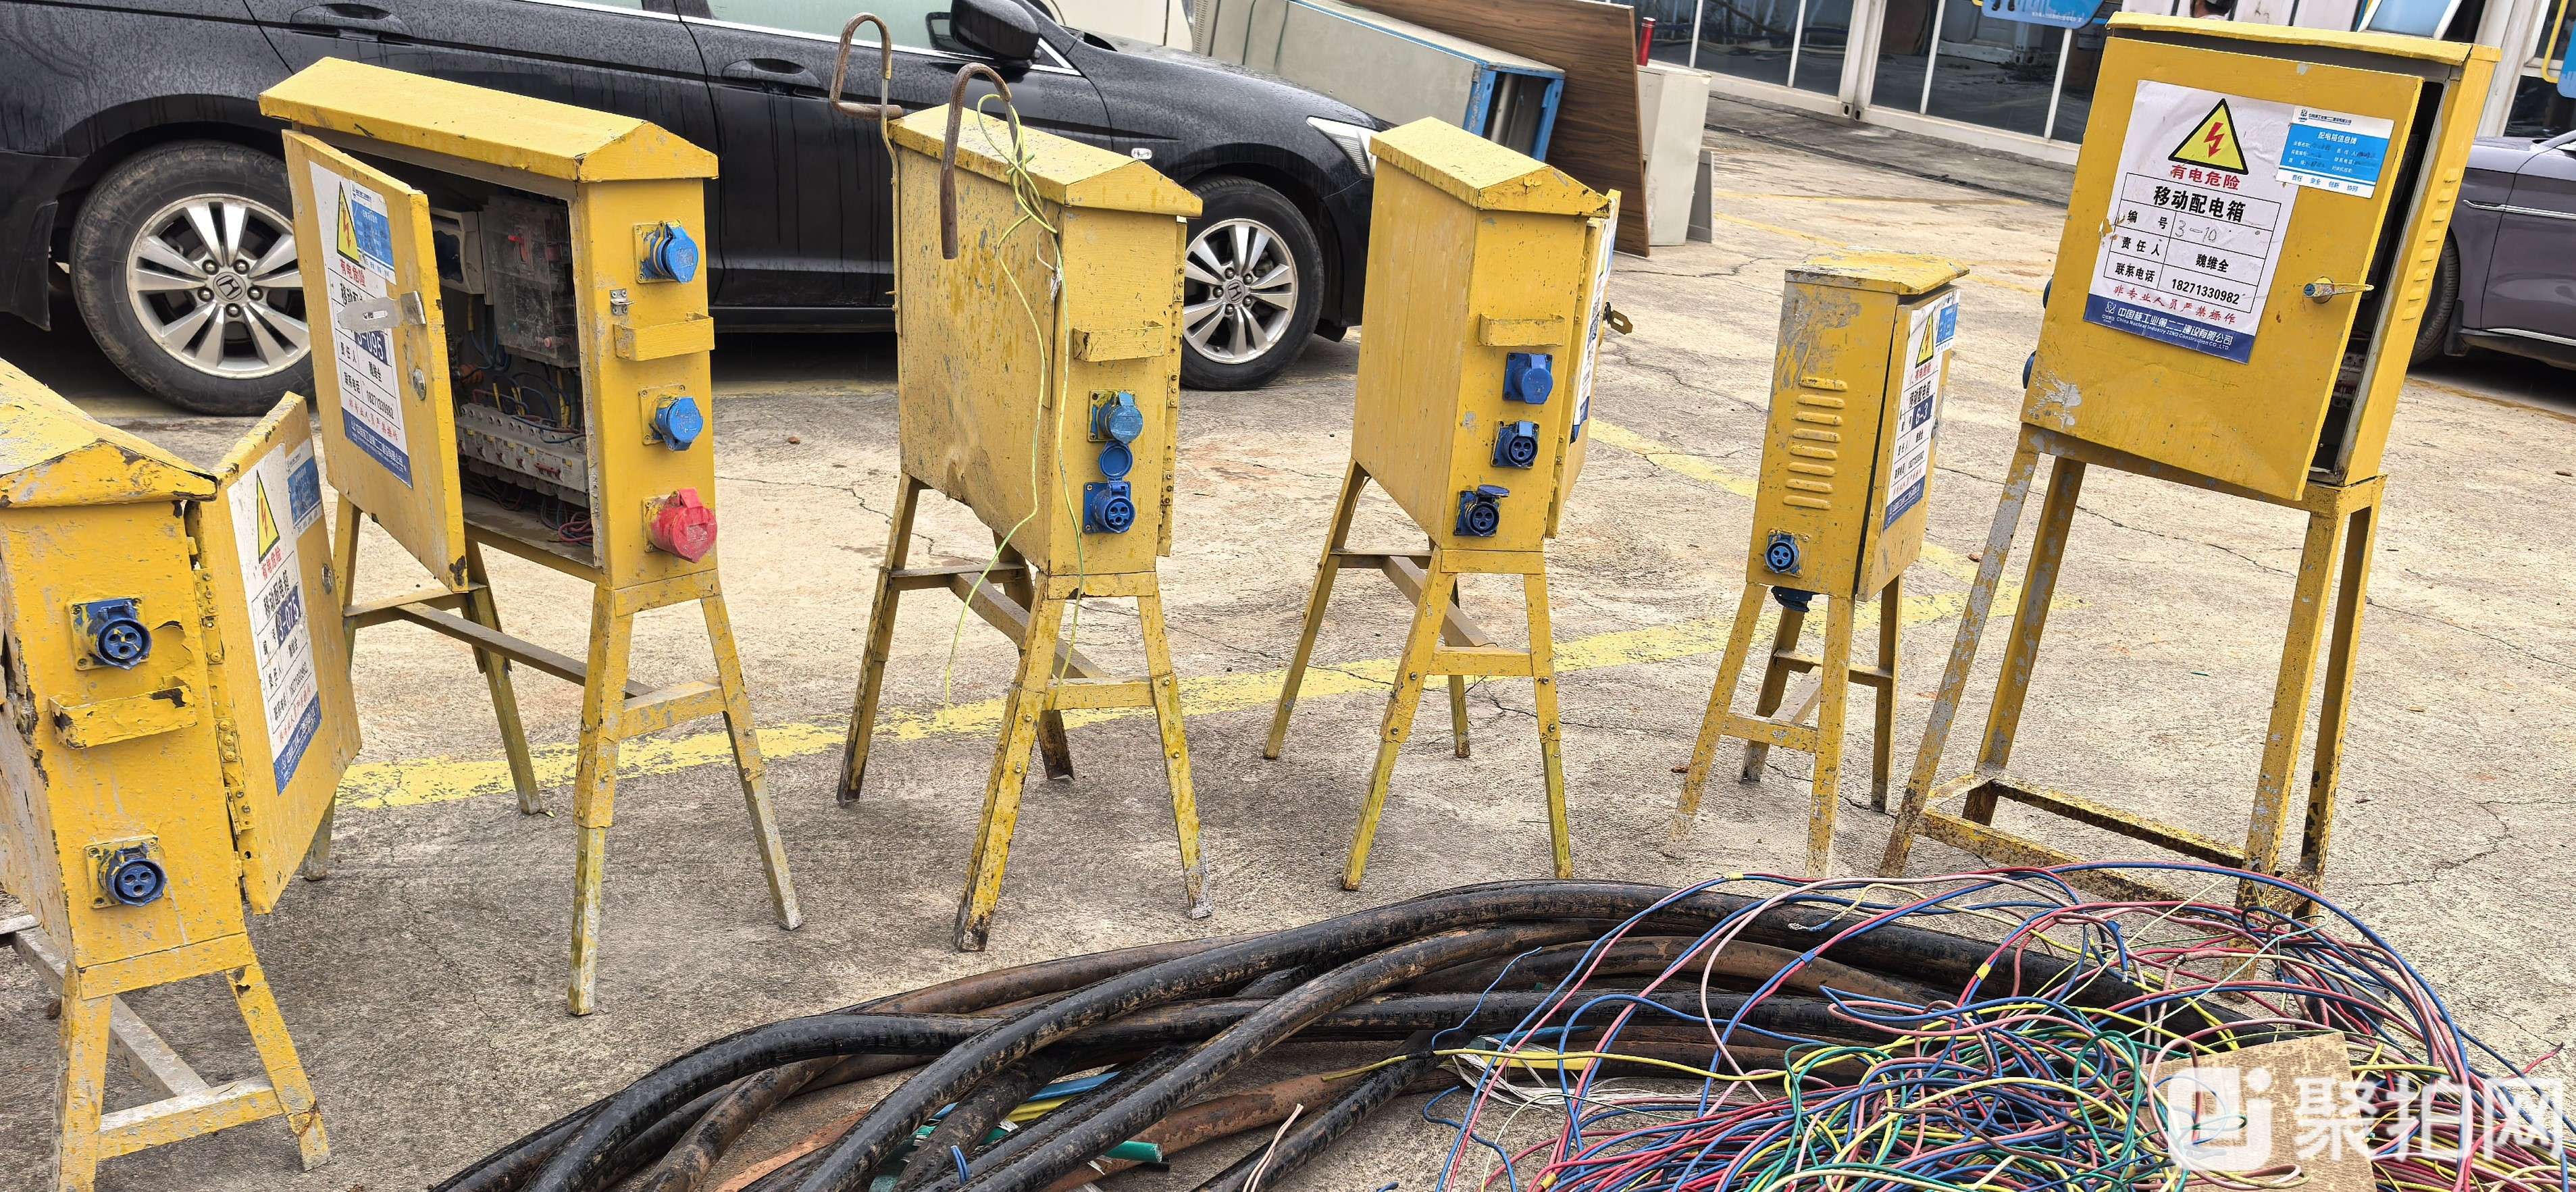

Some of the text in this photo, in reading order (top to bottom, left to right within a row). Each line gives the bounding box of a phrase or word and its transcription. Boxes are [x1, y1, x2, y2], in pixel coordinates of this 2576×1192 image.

[2170, 164, 2240, 190] 有电危险
[2153, 185, 2246, 222] 移动配电箱
[2121, 236, 2161, 256] 责任人
[340, 259, 366, 288] 有电危险
[2115, 262, 2156, 283] 联系电话
[2196, 254, 2229, 273] 魏维全
[2113, 284, 2237, 324] 非专业人员严禁操作
[2171, 278, 2240, 305] 18271330982
[2117, 307, 2234, 345] 中国核工业第二二建设有限公司
[2147, 325, 2166, 335] Industry
[1915, 403, 1928, 425] 6-3
[263, 569, 290, 621] 移动配电箱
[279, 596, 300, 642] 3-075
